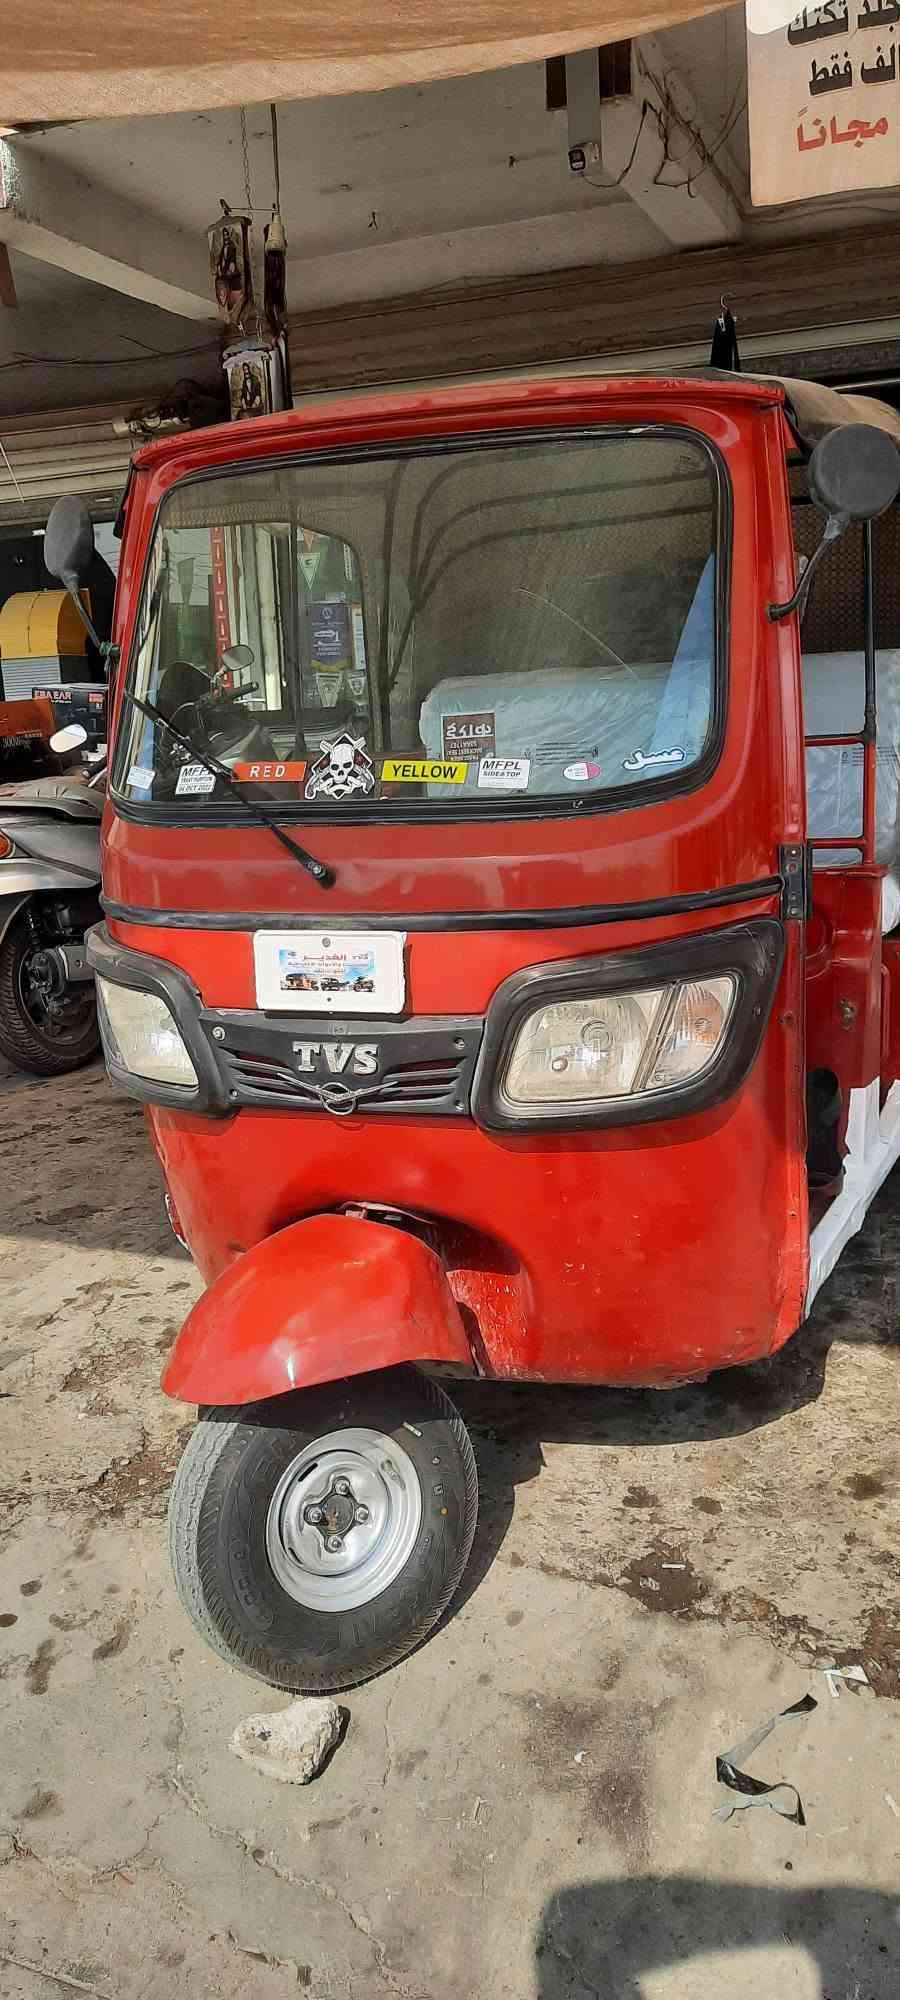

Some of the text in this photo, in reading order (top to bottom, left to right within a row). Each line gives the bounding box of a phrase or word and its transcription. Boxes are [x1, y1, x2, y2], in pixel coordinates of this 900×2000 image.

[809, 42, 900, 95] لف فقط
[182, 767, 212, 776] MFP
[249, 764, 286, 778] RED
[392, 764, 459, 779] YELLOW
[482, 760, 521, 770] MFPL
[292, 1041, 379, 1075] TVS
